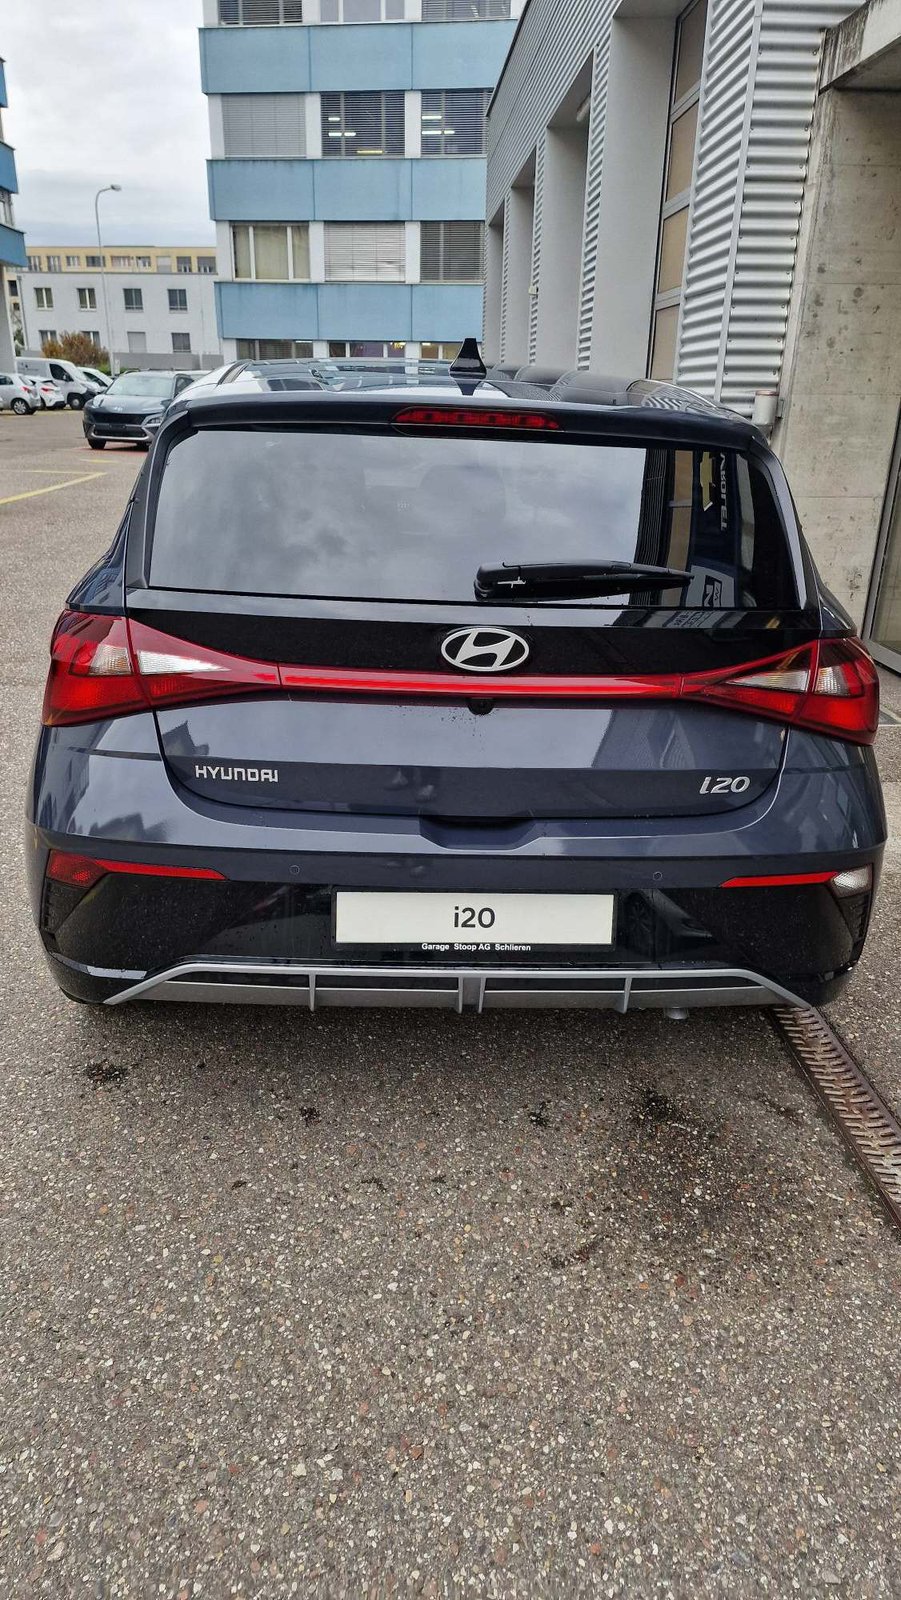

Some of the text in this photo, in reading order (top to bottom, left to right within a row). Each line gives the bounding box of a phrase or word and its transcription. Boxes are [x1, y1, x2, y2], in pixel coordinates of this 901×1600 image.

[194, 765, 279, 782] HYUNDAI
[699, 776, 751, 795] i20
[453, 906, 496, 928] i20
[421, 942, 450, 951] Garage
[453, 943, 477, 951] Stoop
[494, 943, 531, 951] Schlieren
